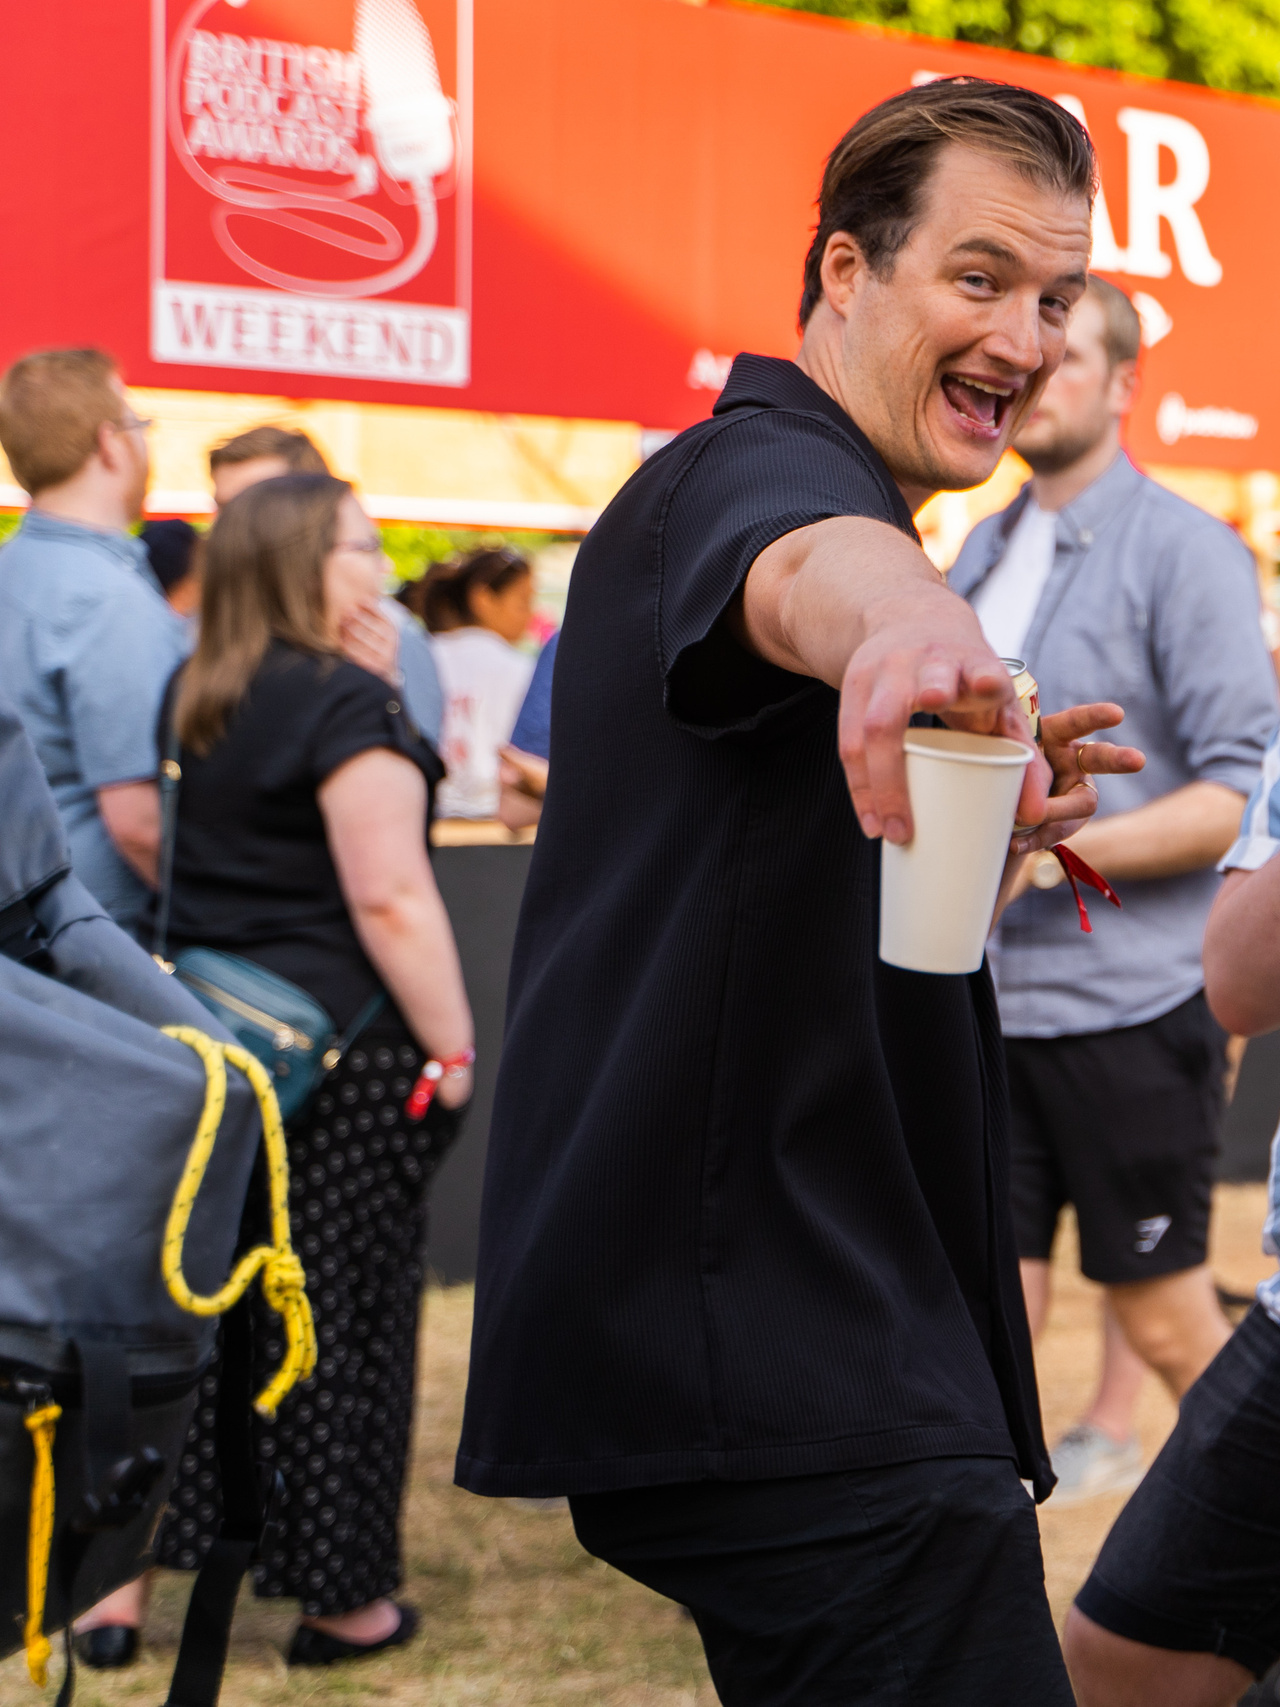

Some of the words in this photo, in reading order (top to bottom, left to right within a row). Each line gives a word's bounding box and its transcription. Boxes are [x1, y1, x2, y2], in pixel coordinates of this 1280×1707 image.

[187, 29, 361, 99] BRITISH
[186, 73, 359, 138] PODCAST
[187, 115, 360, 174] AWARDS
[169, 300, 455, 374] WEEKEND
